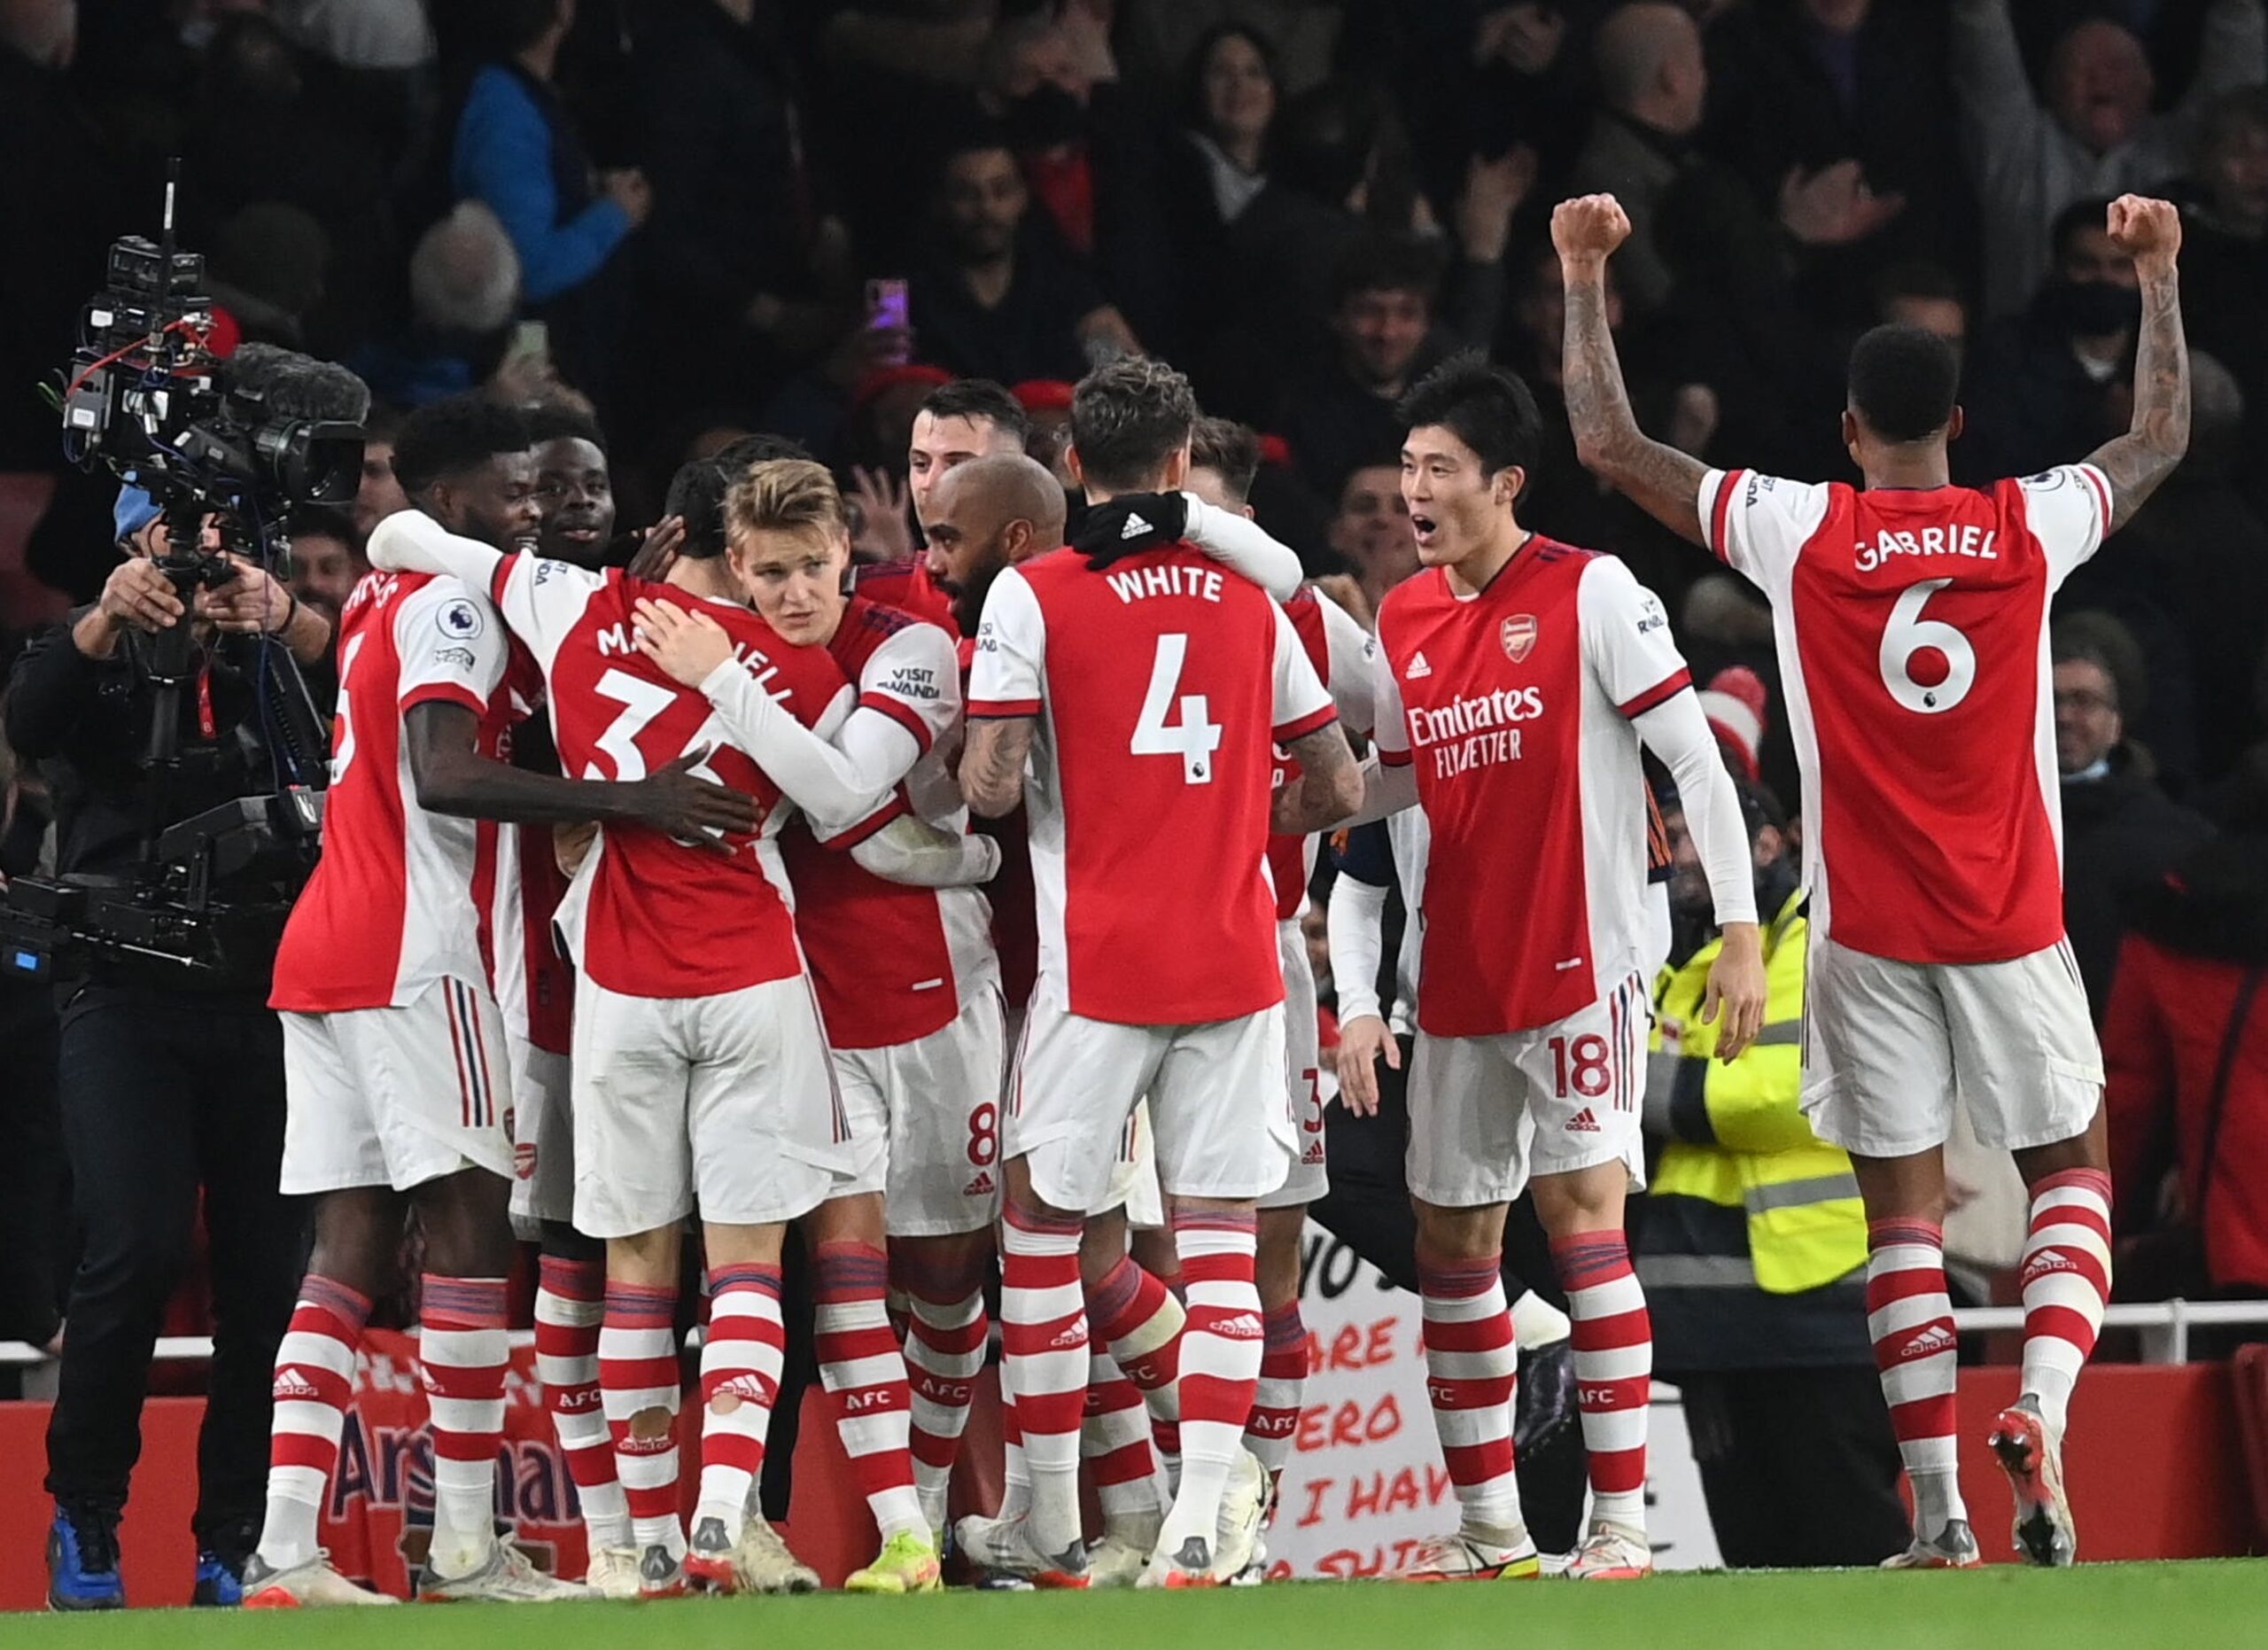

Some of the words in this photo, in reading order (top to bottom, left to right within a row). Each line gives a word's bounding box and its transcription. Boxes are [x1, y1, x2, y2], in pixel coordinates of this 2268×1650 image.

[1854, 524, 1998, 572] GABRIEL
[1106, 564, 1224, 604] WHITE
[1878, 578, 1977, 714] 6
[891, 667, 935, 684] VISIT
[1130, 633, 1223, 785] 4
[1407, 686, 1544, 746] Emirates
[1548, 1032, 1612, 1098] 18
[1301, 1068, 1323, 1133] 3
[967, 1101, 997, 1166] 8
[559, 1389, 602, 1407] AFC
[846, 1390, 891, 1411] AFC
[921, 1378, 968, 1399] AFC
[1430, 1386, 1456, 1403] FC
[1254, 1415, 1294, 1432] AFC
[1296, 1393, 1404, 1453] ERO
[1346, 1462, 1449, 1521] HAV
